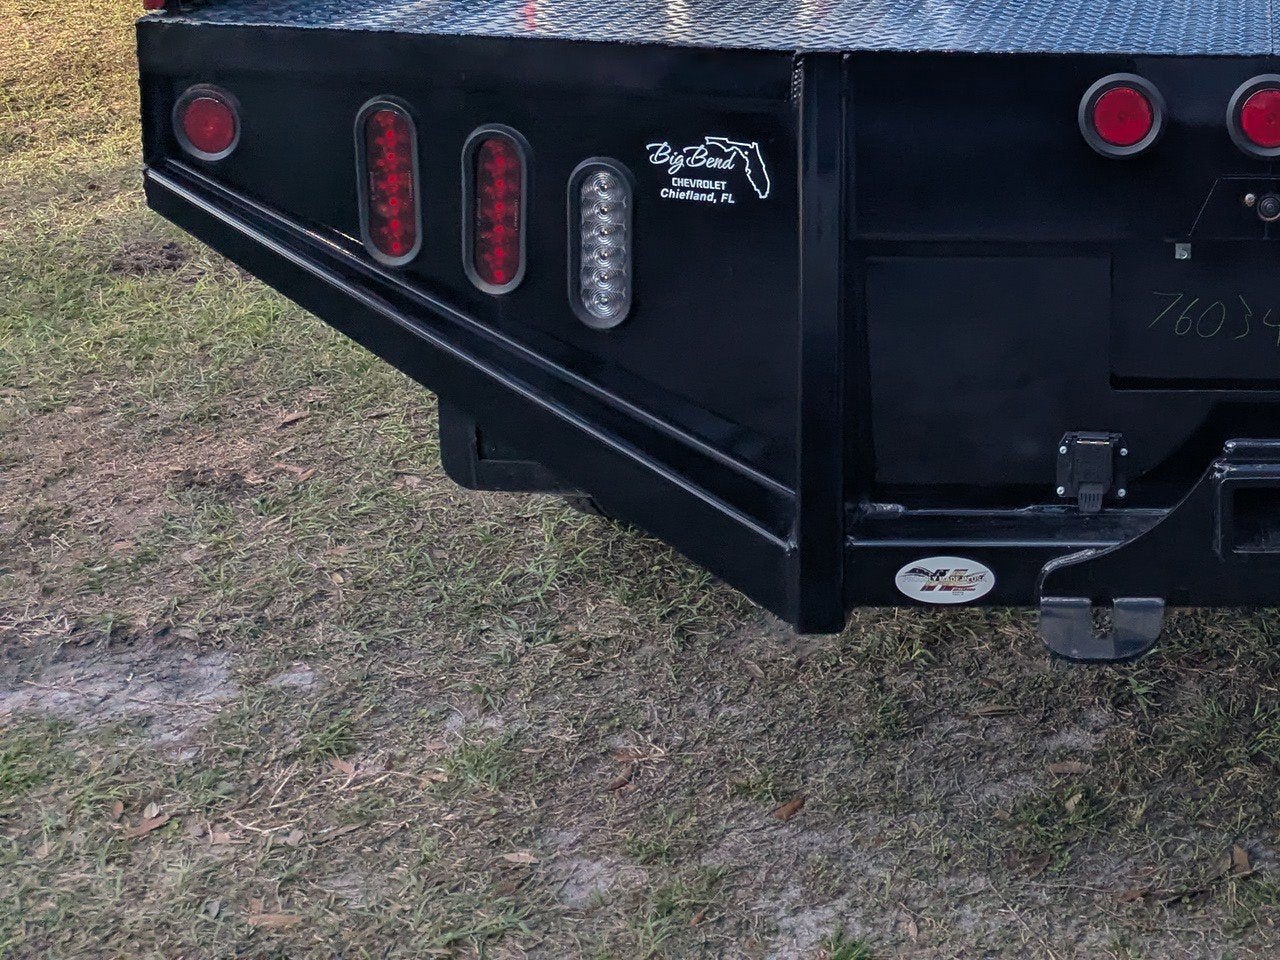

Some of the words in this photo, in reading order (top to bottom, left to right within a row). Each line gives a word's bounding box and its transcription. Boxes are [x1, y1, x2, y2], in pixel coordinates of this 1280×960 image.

[646, 141, 685, 175] Big
[683, 145, 737, 170] Bend
[671, 177, 727, 191] CHEVROLET
[660, 188, 717, 204] Chiefland,
[721, 191, 735, 204] FL
